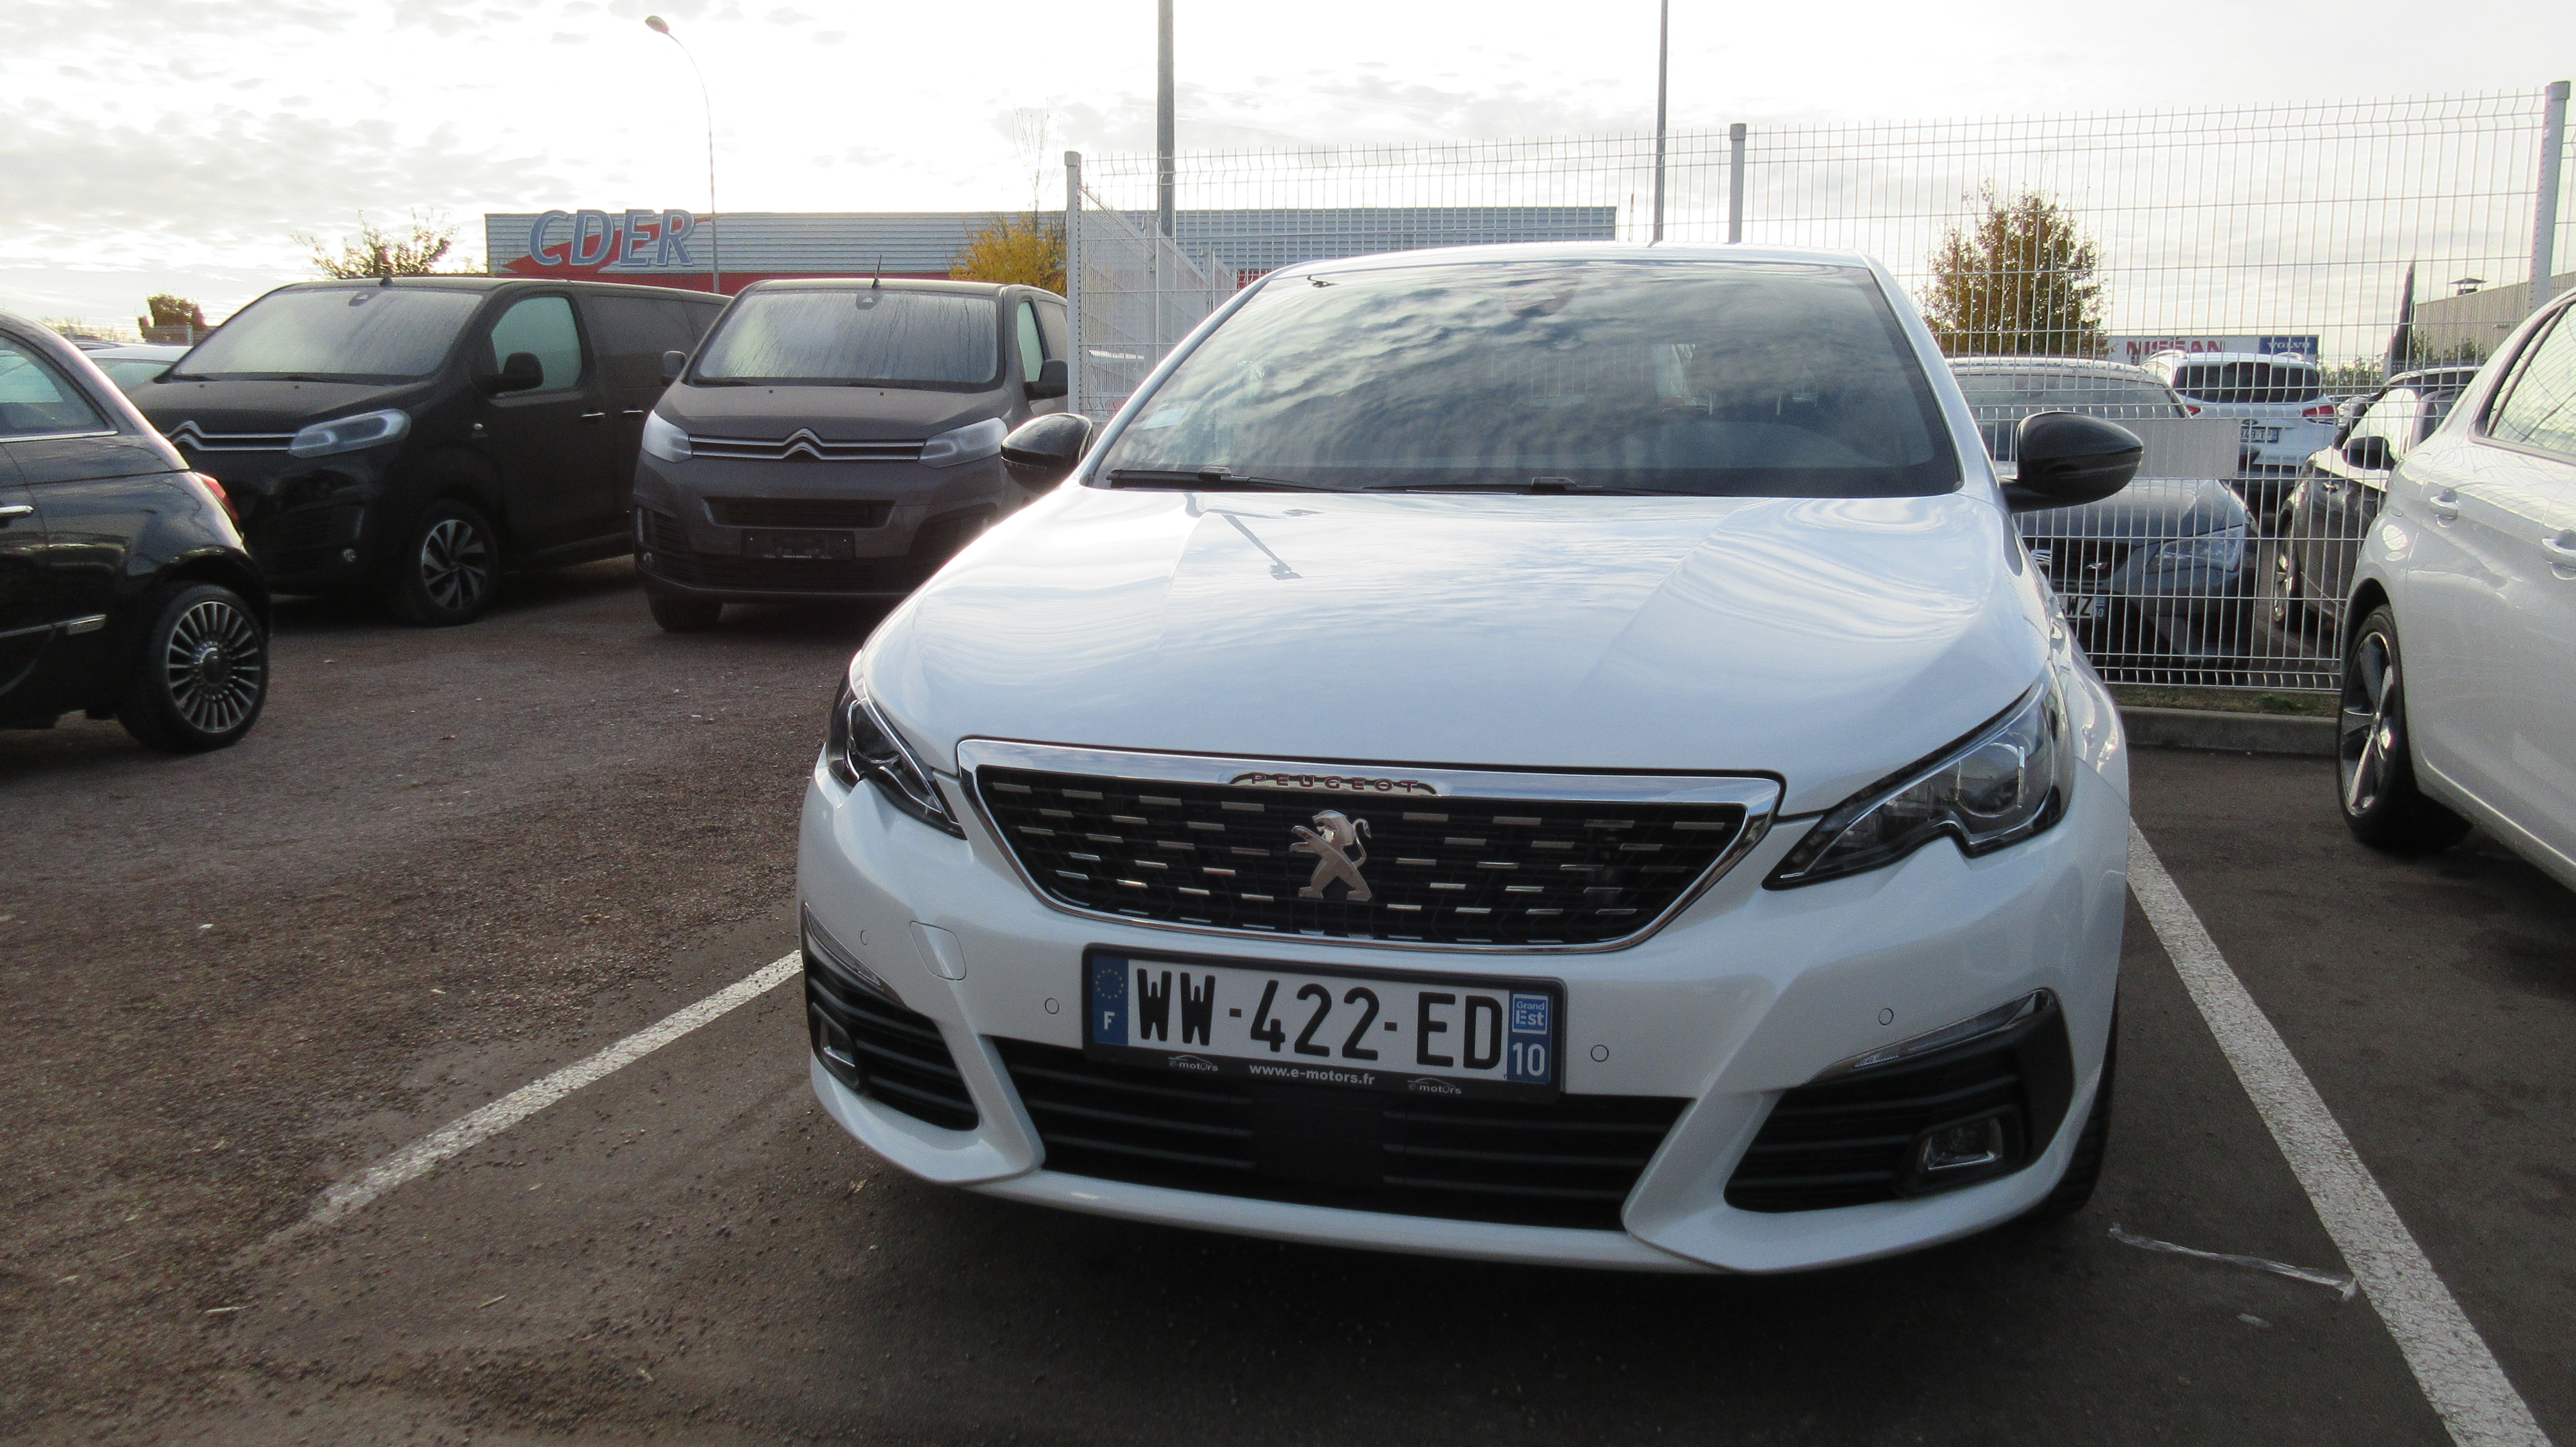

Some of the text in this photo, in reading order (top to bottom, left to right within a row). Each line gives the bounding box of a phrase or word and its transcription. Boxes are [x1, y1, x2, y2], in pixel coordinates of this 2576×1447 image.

[529, 209, 695, 266] CDER
[2127, 340, 2224, 355] NISSAN
[1251, 772, 1419, 793] PEUGEOT
[1517, 1001, 1545, 1010] Grand
[1103, 1011, 1115, 1030] F
[1137, 968, 1503, 1070] WW-422-ED
[1516, 1010, 1544, 1026] Est
[1512, 1042, 1545, 1076] 10
[1249, 1064, 1375, 1085] www.e-motors.fr
